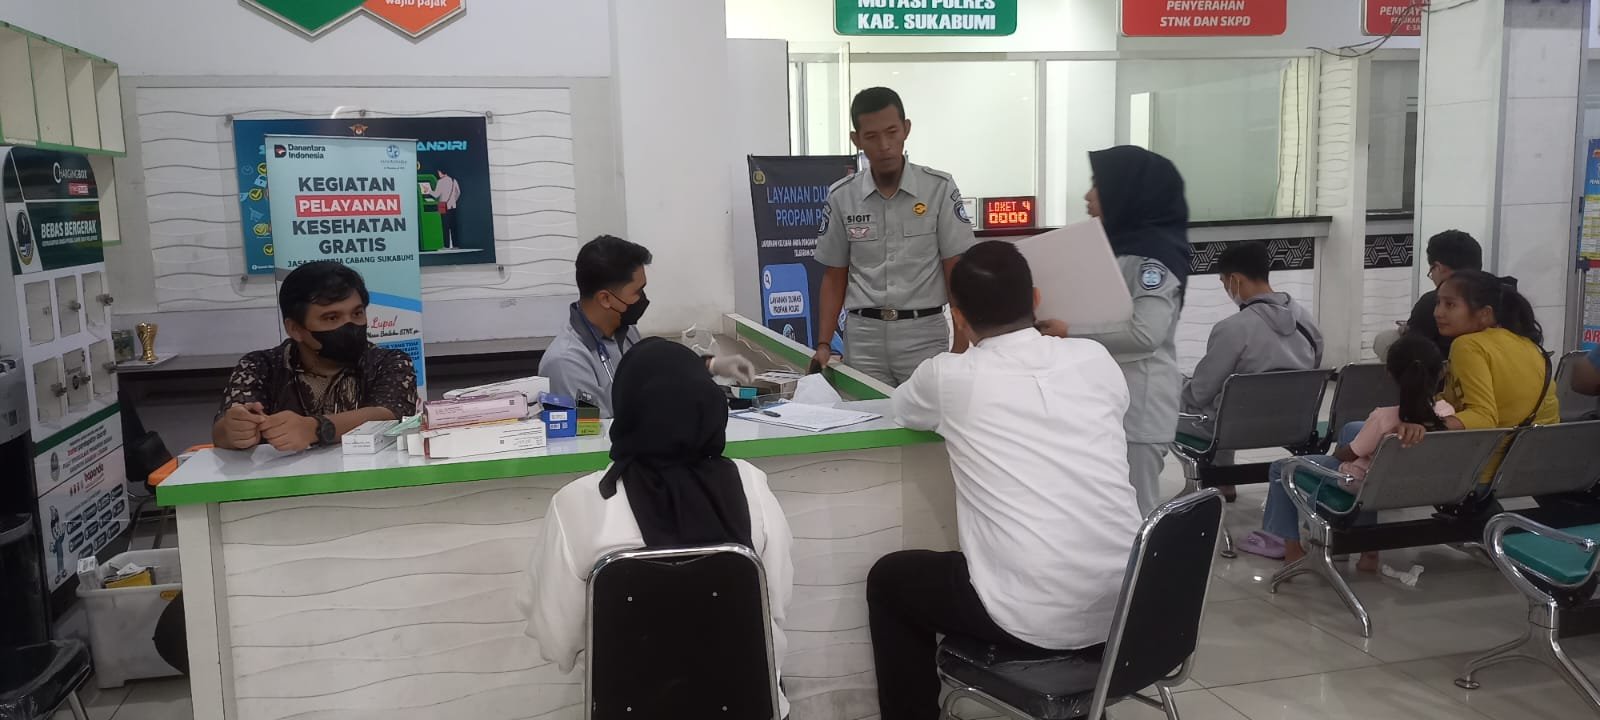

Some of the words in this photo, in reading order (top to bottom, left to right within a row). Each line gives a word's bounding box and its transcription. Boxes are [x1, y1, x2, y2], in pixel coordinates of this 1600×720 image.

[417, 0, 447, 8] pajak
[931, 0, 995, 9] POLRES
[1166, 0, 1245, 11] PENYERAHAN
[857, 13, 899, 29] KAB.
[904, 14, 996, 30] SUKABUMI
[1159, 16, 1191, 27] STNK
[1193, 16, 1218, 27] DAN
[1220, 16, 1251, 26] SKPD
[288, 144, 326, 152] Danantara
[288, 151, 325, 159] Indonesia
[298, 177, 395, 192] KEGIATAN
[767, 186, 811, 203] LAYANAN
[299, 199, 398, 213] PELAYANAN
[988, 201, 1017, 212] LOKET
[1022, 200, 1031, 211] 4
[776, 208, 814, 226] PROPAM
[847, 214, 871, 223] SIGIT
[41, 222, 64, 239] BEBAS
[65, 219, 97, 237] BERGERAK
[292, 217, 406, 235] KESEHATAN
[318, 237, 386, 255] GRATIS
[345, 256, 375, 265] CABANG
[377, 254, 414, 263] SUKABUMI
